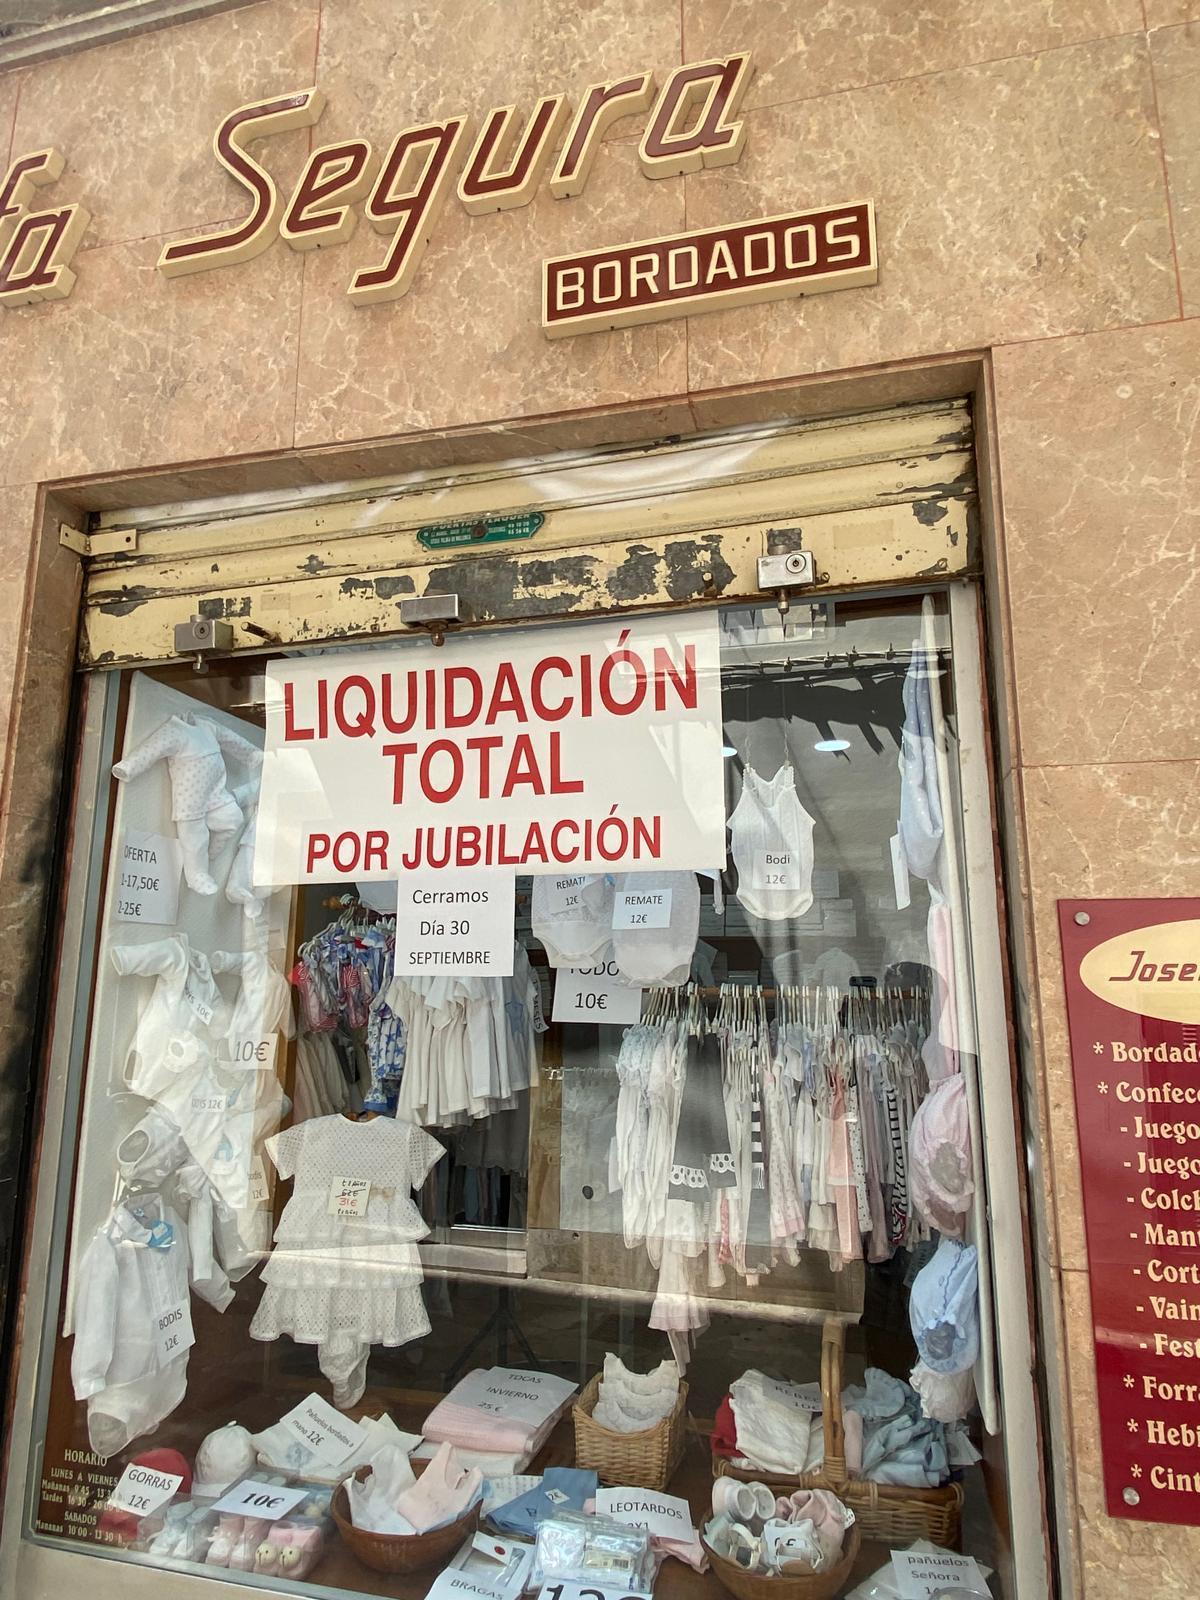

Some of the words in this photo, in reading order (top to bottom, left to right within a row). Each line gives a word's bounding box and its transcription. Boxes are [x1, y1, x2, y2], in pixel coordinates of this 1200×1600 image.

[160, 52, 752, 298] Segura
[555, 213, 862, 311] BORDADOS
[284, 629, 698, 742] LIQUIDACIÓN
[383, 731, 584, 805] TOTAL
[307, 831, 389, 873] POR
[402, 804, 661, 871] JUBILACIÓN
[124, 845, 157, 864] OFERTA
[766, 854, 790, 865] Bodi
[556, 875, 586, 890] REMAT
[765, 874, 787, 884] 12€
[412, 888, 489, 904] Cerramos
[625, 895, 664, 905] REMATE
[420, 919, 446, 936] Día
[451, 920, 471, 936] 30
[630, 914, 648, 924] 12€
[408, 951, 491, 965] SEPTIEMBRE
[1109, 950, 1200, 982] Jose
[574, 993, 609, 1010] 10€
[235, 1040, 271, 1062] 10€
[1111, 1041, 1200, 1063] Bordad
[1116, 1081, 1200, 1104] Confec
[1134, 1116, 1200, 1144] Juego
[1144, 1222, 1200, 1247] Man
[1147, 1259, 1200, 1284] Cort
[158, 1309, 183, 1330] BODIS
[165, 1334, 180, 1352] 12€
[486, 1387, 539, 1401] INVIERNO
[1142, 1375, 1200, 1401] Forr
[307, 1430, 325, 1446] 12€
[64, 1449, 108, 1467] HORARIO
[51, 1467, 74, 1480] LUNES
[77, 1472, 83, 1482] A
[87, 1473, 119, 1487] VIERNES
[128, 1469, 172, 1491] GORRAS
[42, 1491, 63, 1503] Tardes
[127, 1494, 151, 1510] 12€
[241, 1493, 285, 1509] 10€
[610, 1502, 683, 1519] LEOTARDOS
[911, 1570, 960, 1581] Señora
[450, 1579, 504, 1600] BRAGAS
